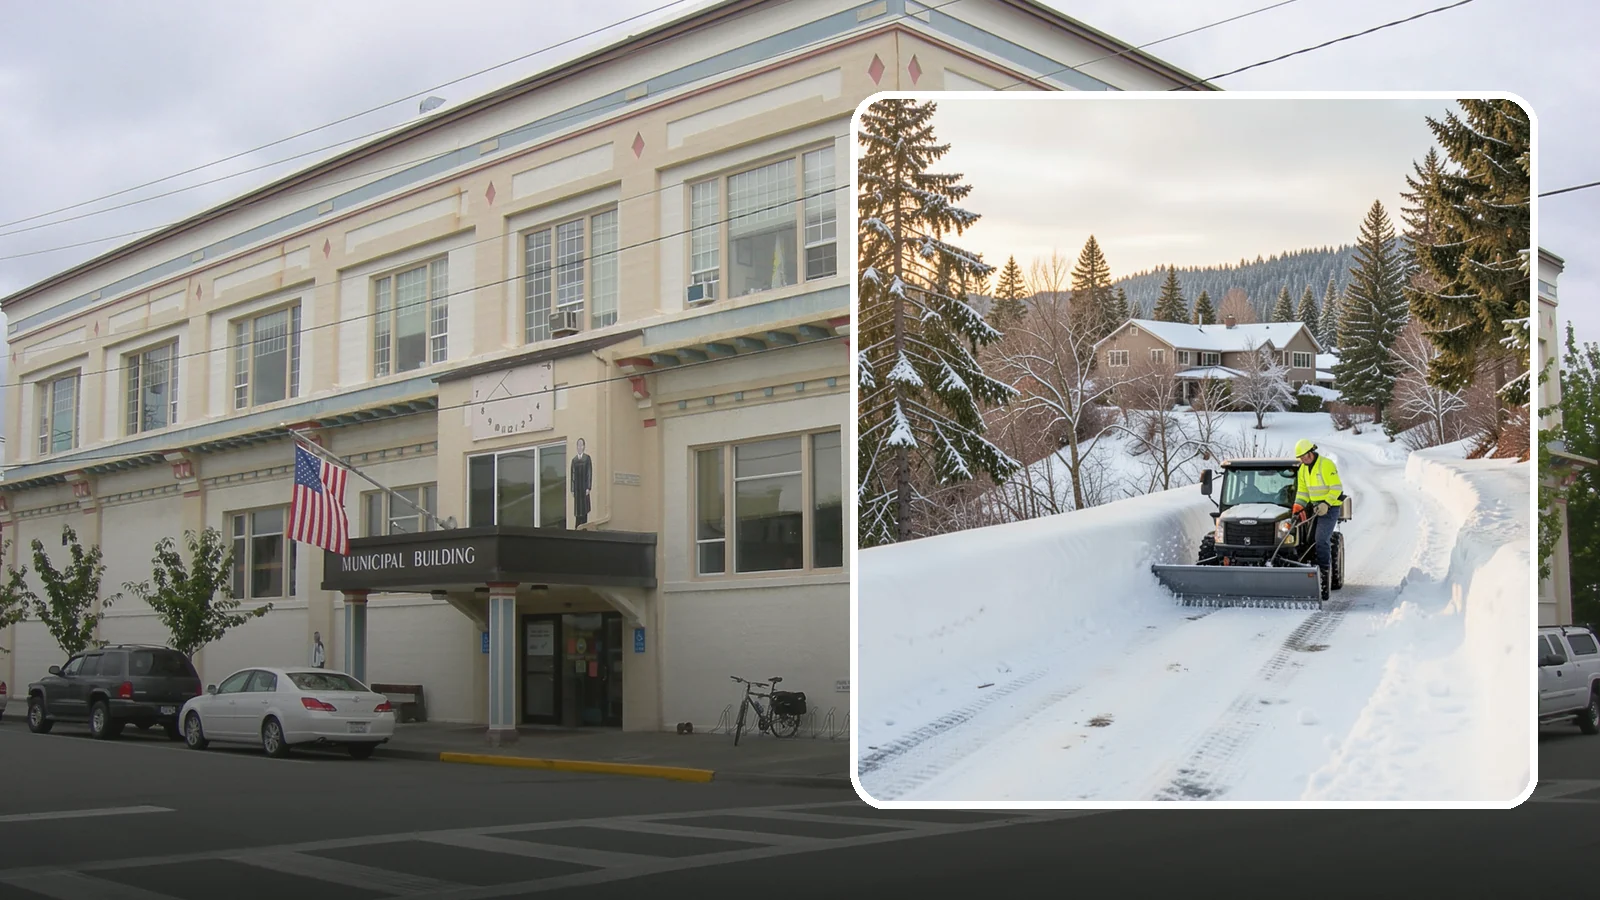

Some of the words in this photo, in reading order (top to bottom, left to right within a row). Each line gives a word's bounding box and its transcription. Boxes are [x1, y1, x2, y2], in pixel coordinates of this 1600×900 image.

[487, 417, 493, 426] 9
[521, 420, 526, 428] 2
[494, 423, 500, 432] 10
[507, 425, 514, 434] 12
[342, 552, 405, 572] MUNICIPAL
[414, 546, 475, 567] BUILDING
